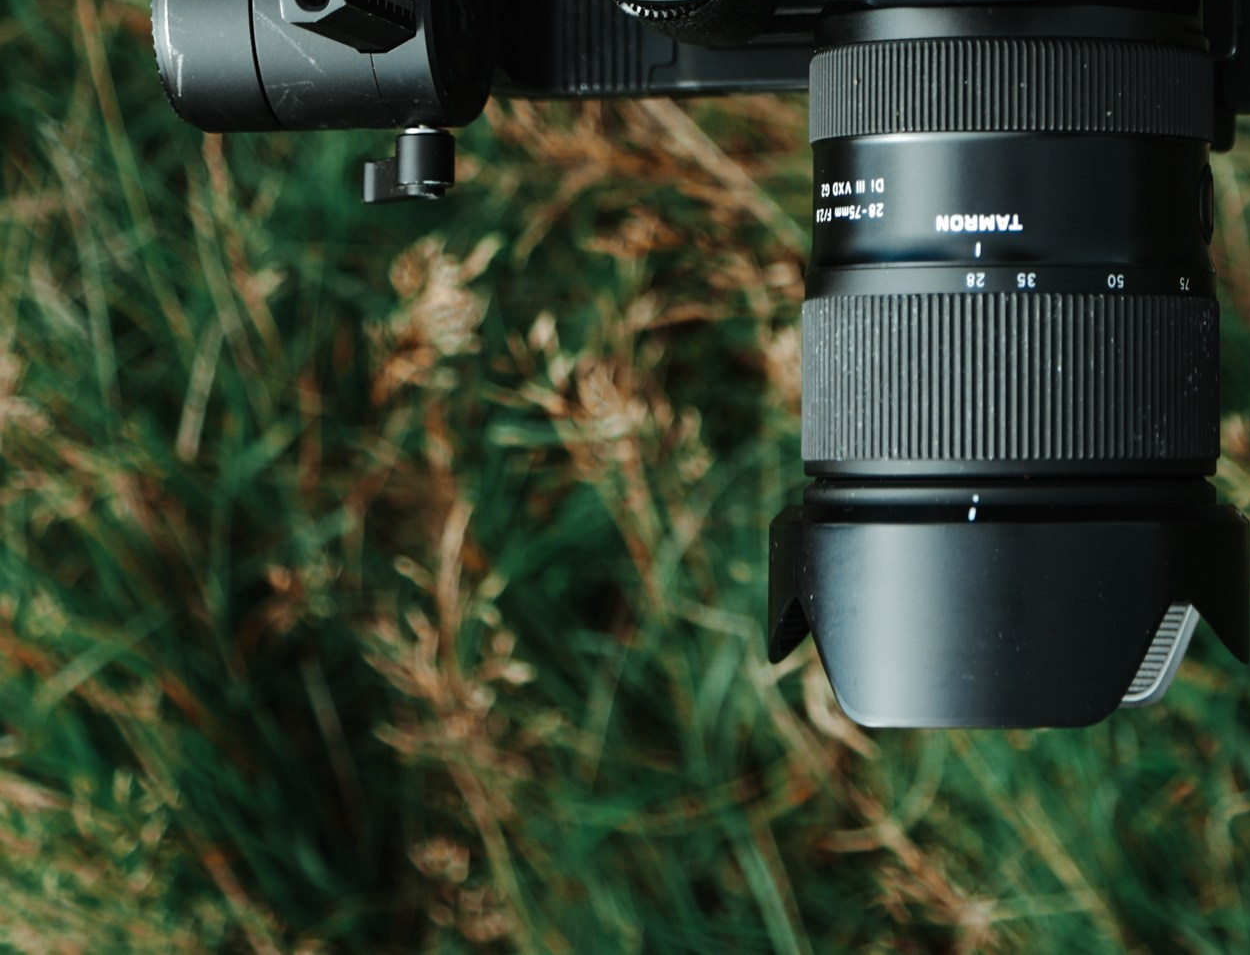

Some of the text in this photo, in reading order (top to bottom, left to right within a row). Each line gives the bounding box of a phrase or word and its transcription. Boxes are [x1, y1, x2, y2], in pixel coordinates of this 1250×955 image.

[832, 180, 852, 196] VXD
[871, 177, 885, 194] Di
[834, 202, 885, 220] 28-75mm
[935, 213, 1024, 232] TAMRON
[965, 272, 1190, 291] 28 35 50 75
